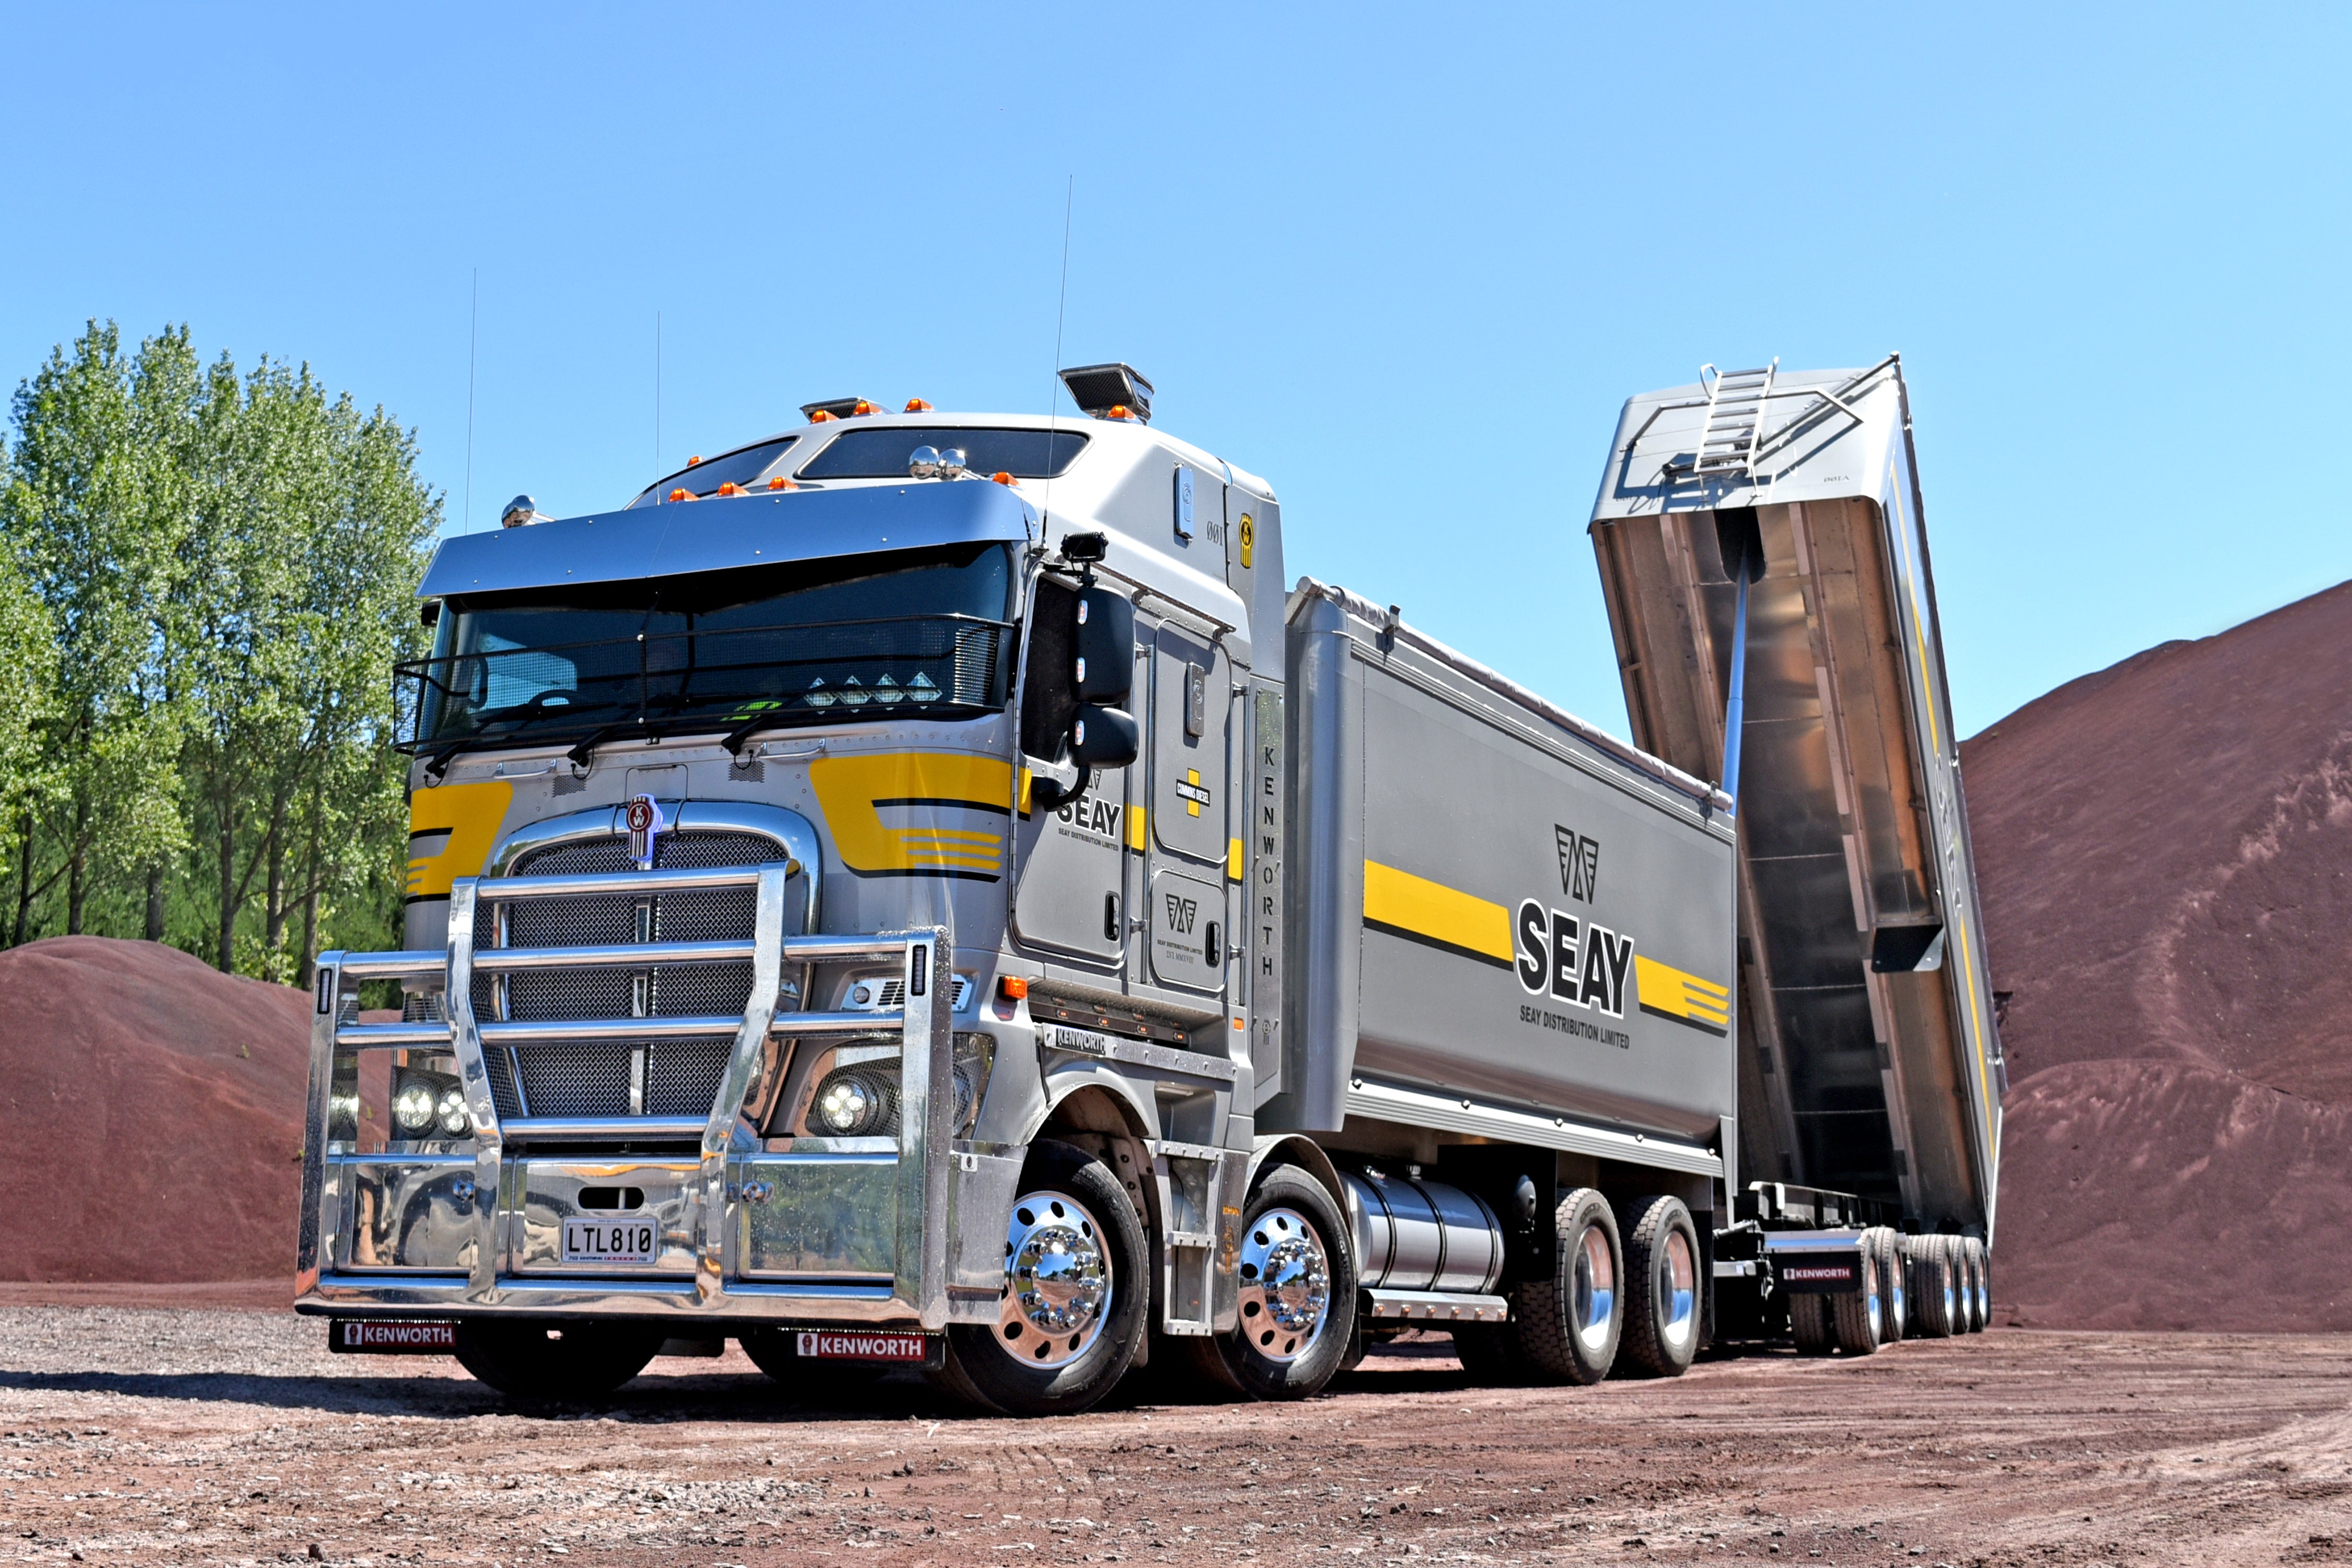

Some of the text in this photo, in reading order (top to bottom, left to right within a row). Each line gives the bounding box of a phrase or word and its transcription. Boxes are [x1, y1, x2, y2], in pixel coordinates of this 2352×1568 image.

[1177, 782, 1209, 804] CUMMINS DIESEL
[1058, 827, 1119, 851] SEAY DISTRIBUTION LIMITED
[1262, 746, 1274, 976] KENWORTH
[1167, 941, 1190, 952] DISTRIBUTION
[1190, 947, 1203, 955] LIMITED
[1516, 897, 1635, 1019] SEAY
[1520, 1005, 1629, 1050] SEAY DISTRIBUTION LIMITED
[1057, 1028, 1105, 1051] KENWORTH
[568, 1227, 651, 1253] LTL810
[1795, 1268, 1850, 1278] KENWORTH
[365, 1327, 453, 1343] KENWORTH
[821, 1336, 921, 1356] KENWORTH
